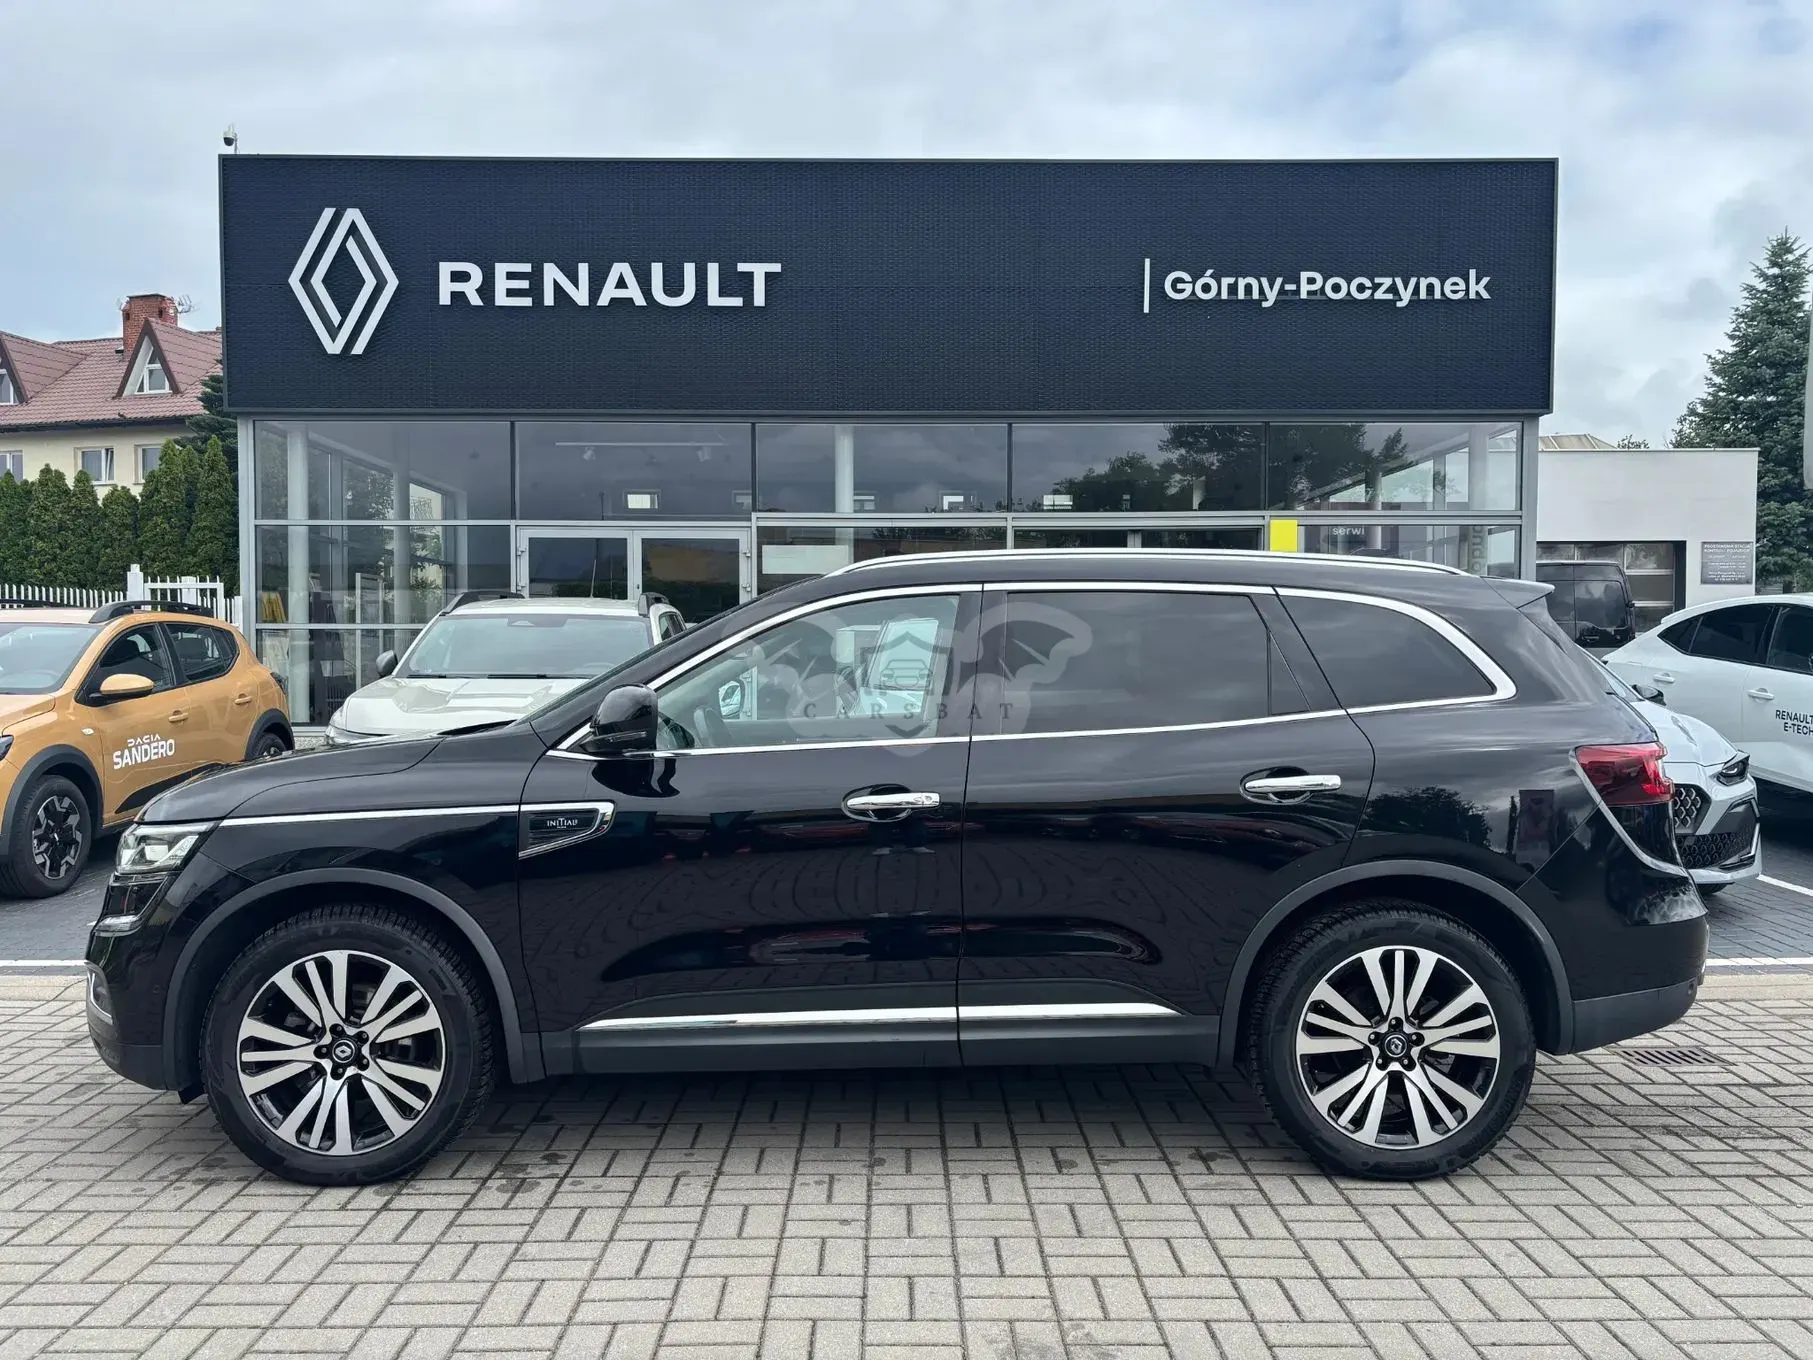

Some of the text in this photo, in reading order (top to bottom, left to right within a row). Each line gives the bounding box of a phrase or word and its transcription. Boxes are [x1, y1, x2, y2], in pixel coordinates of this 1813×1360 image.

[438, 261, 782, 307] RENAULT
[1164, 269, 1492, 308] Górny-Poczynek
[1332, 525, 1365, 535] serwi
[1775, 709, 1813, 725] RENAULT
[1783, 721, 1813, 736] E-TECH
[127, 733, 161, 747] DACIA
[113, 739, 175, 770] SANDERO
